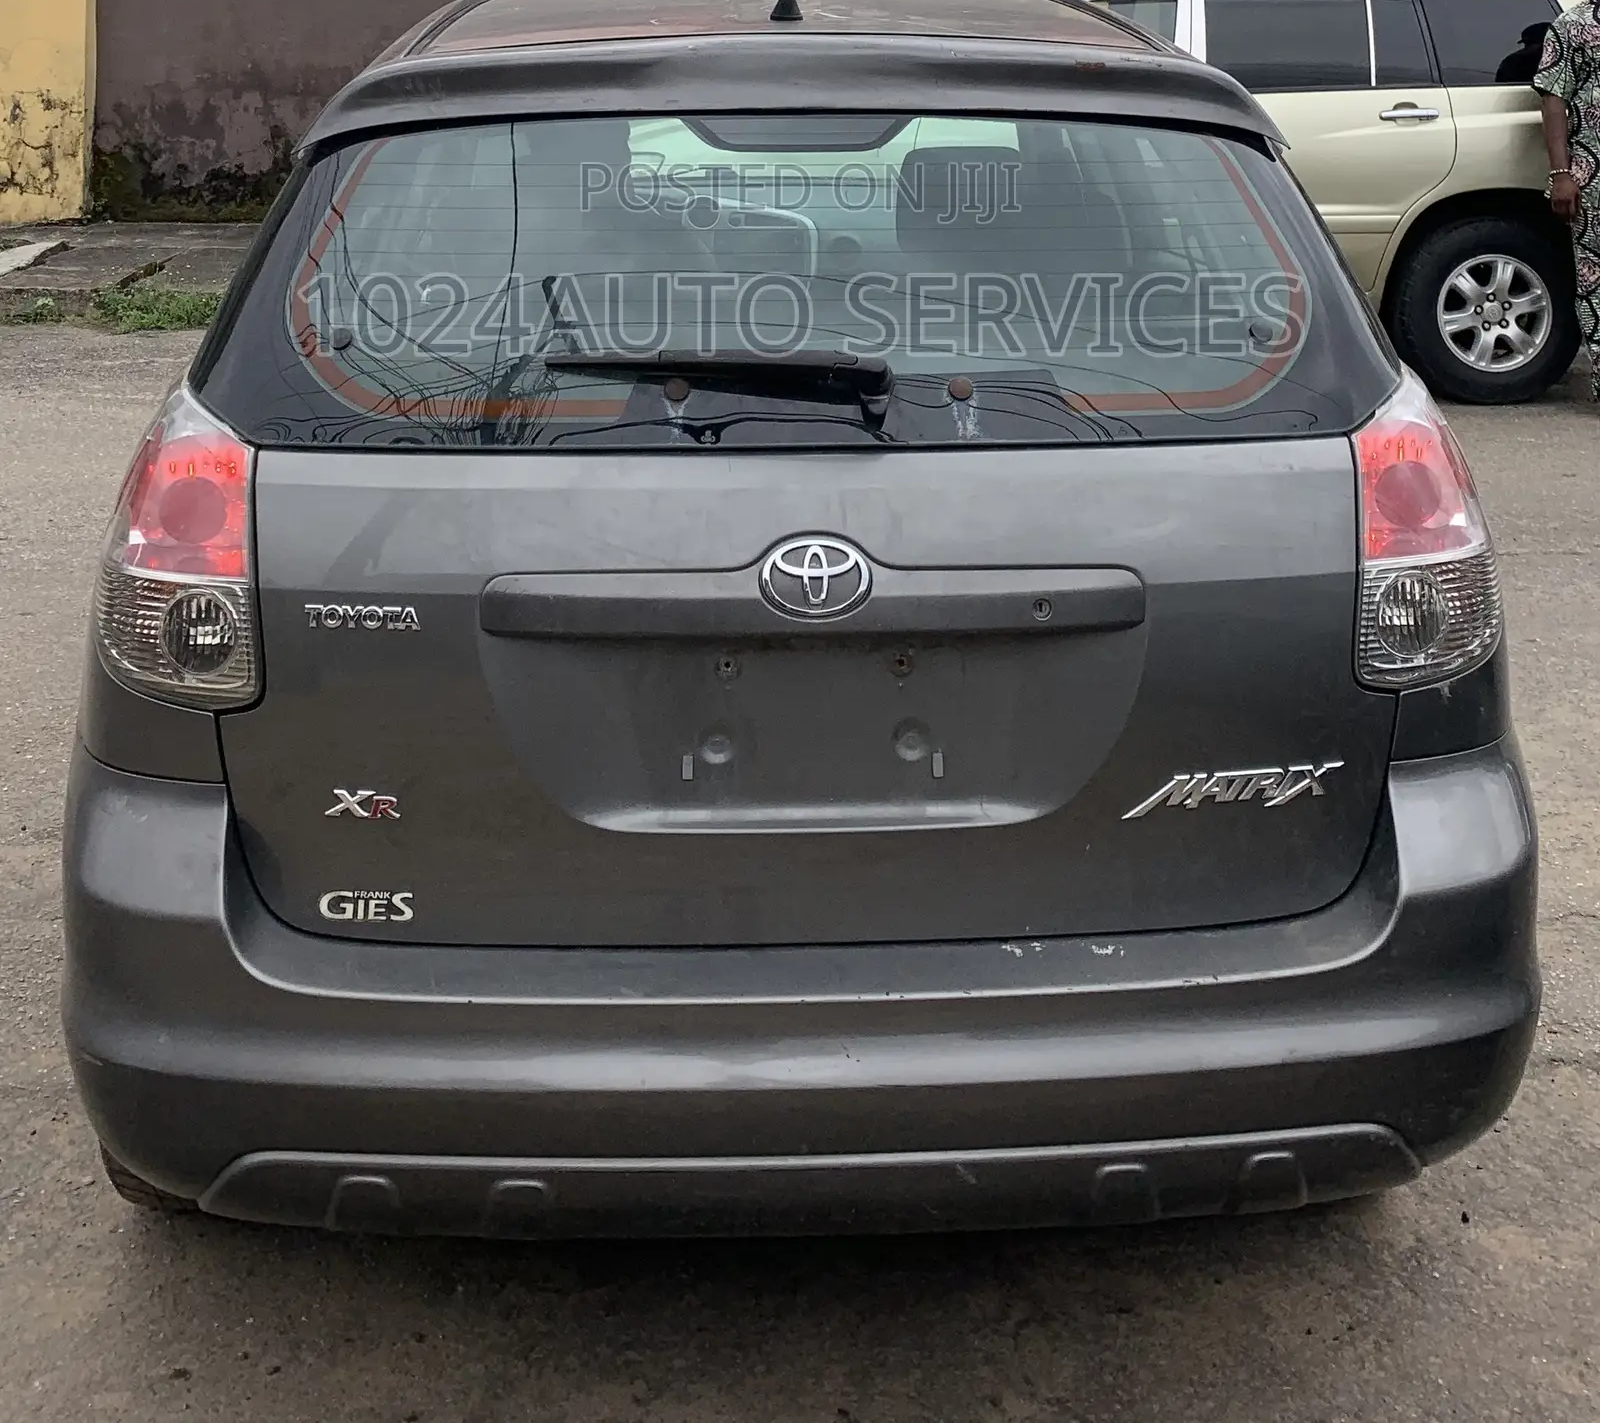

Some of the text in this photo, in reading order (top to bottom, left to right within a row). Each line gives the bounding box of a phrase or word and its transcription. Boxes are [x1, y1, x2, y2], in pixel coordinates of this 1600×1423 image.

[305, 604, 421, 631] TOYOTA
[324, 789, 401, 819] XR
[1121, 761, 1345, 820] MATRIX
[354, 890, 391, 899] FRANK
